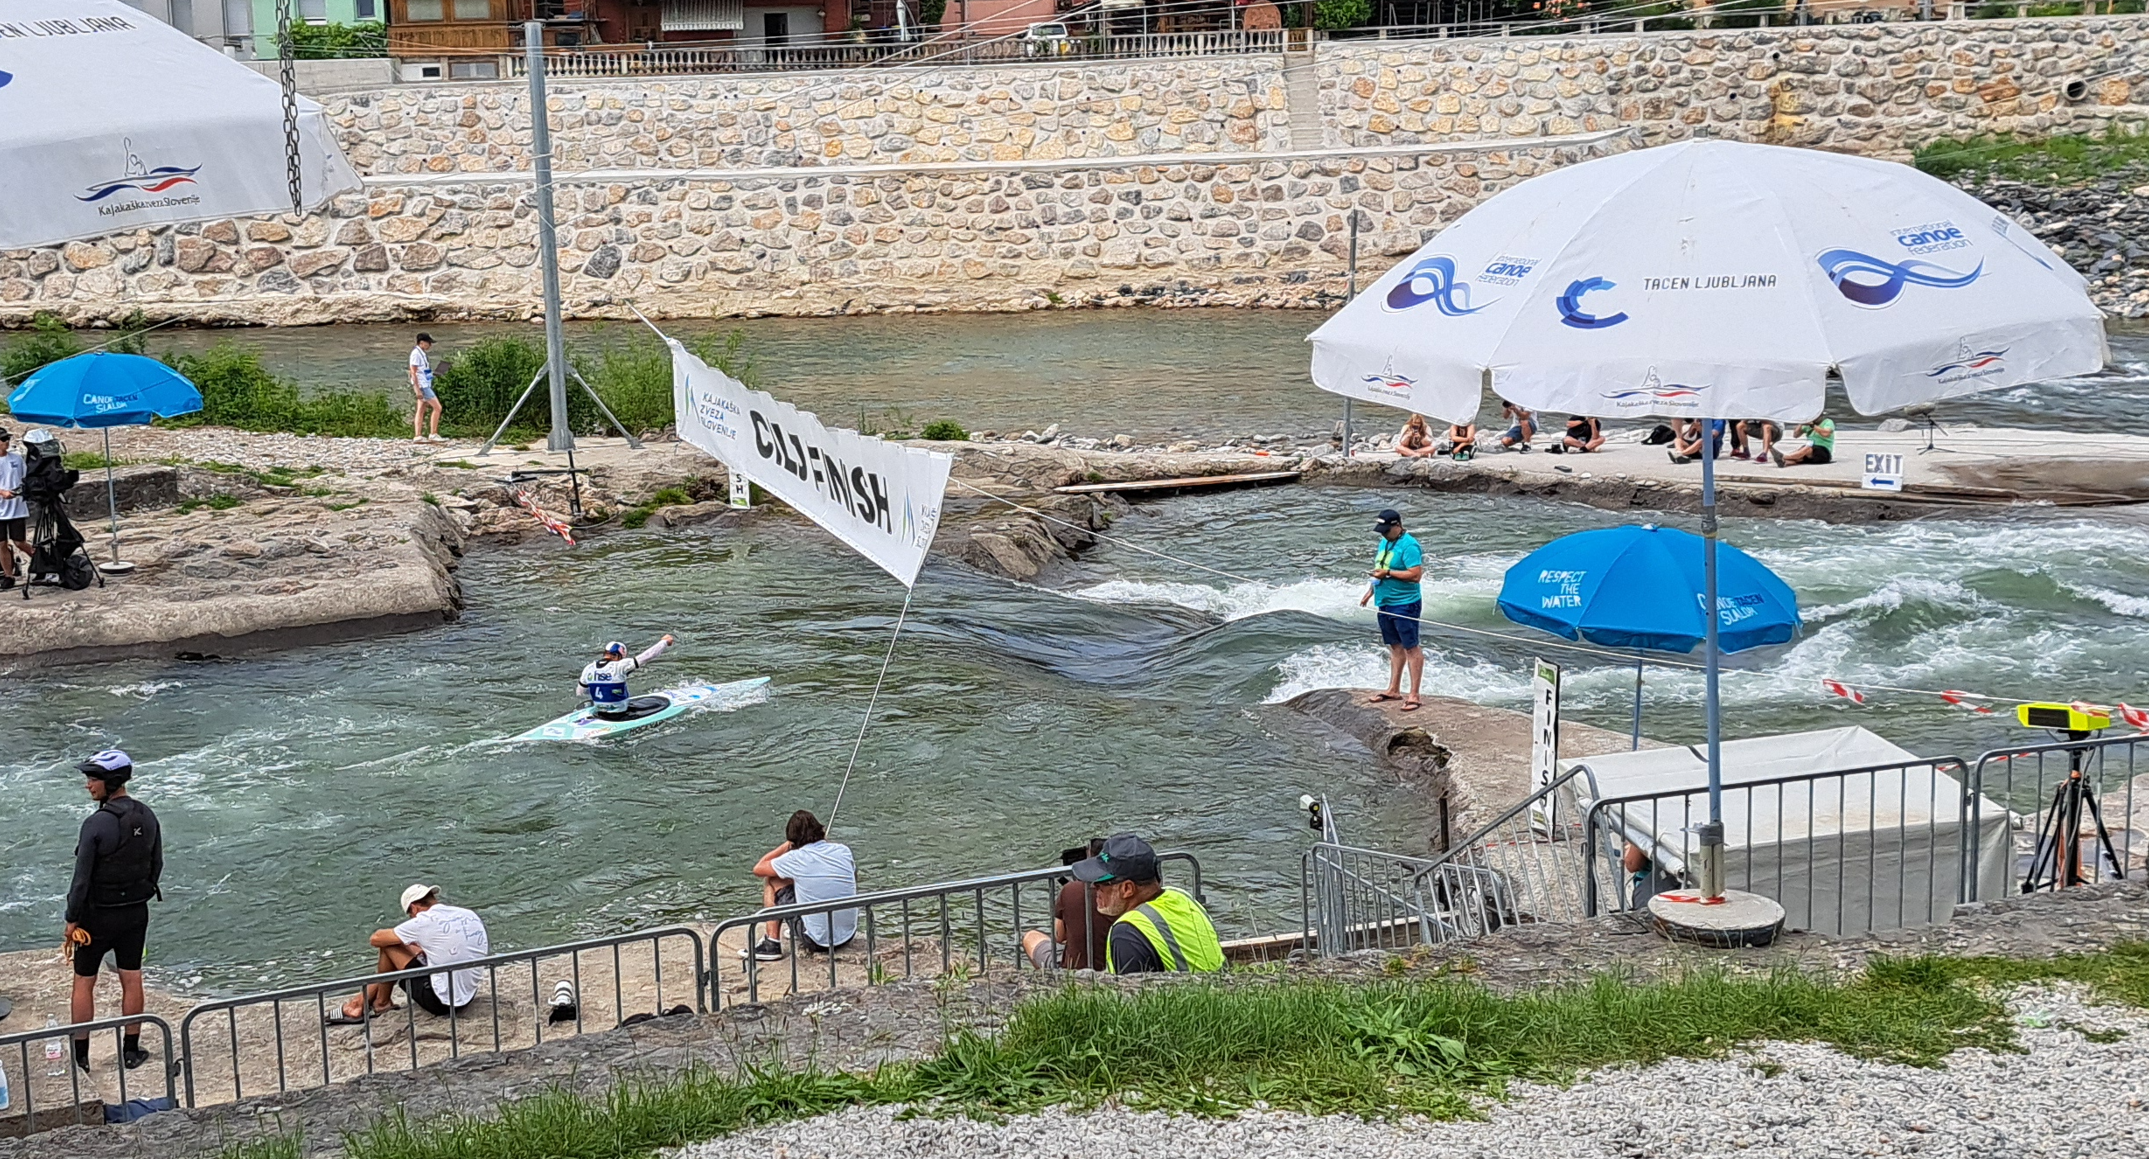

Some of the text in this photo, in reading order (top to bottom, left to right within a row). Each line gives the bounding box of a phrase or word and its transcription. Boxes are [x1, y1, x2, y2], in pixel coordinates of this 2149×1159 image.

[18, 16, 137, 37] LJUBLJANA
[1898, 227, 1965, 248] canoe
[1908, 238, 1973, 255] federation
[1485, 263, 1532, 278] canoe
[1644, 275, 1777, 290] TACEN LJUBLJANA
[95, 401, 128, 414] SLALOM
[702, 391, 740, 415] KAJAKAŠKA
[700, 404, 725, 420] ZVEZA
[750, 409, 808, 482] CILJ
[1865, 453, 1903, 474] EXIT
[1537, 569, 1587, 583] RESPECT
[1560, 583, 1580, 595] THE
[1541, 595, 1582, 609] WATER
[1697, 593, 1736, 611] CNOE
[1720, 606, 1759, 626] SLALOM
[594, 671, 612, 681] hse
[595, 686, 603, 699] 4
